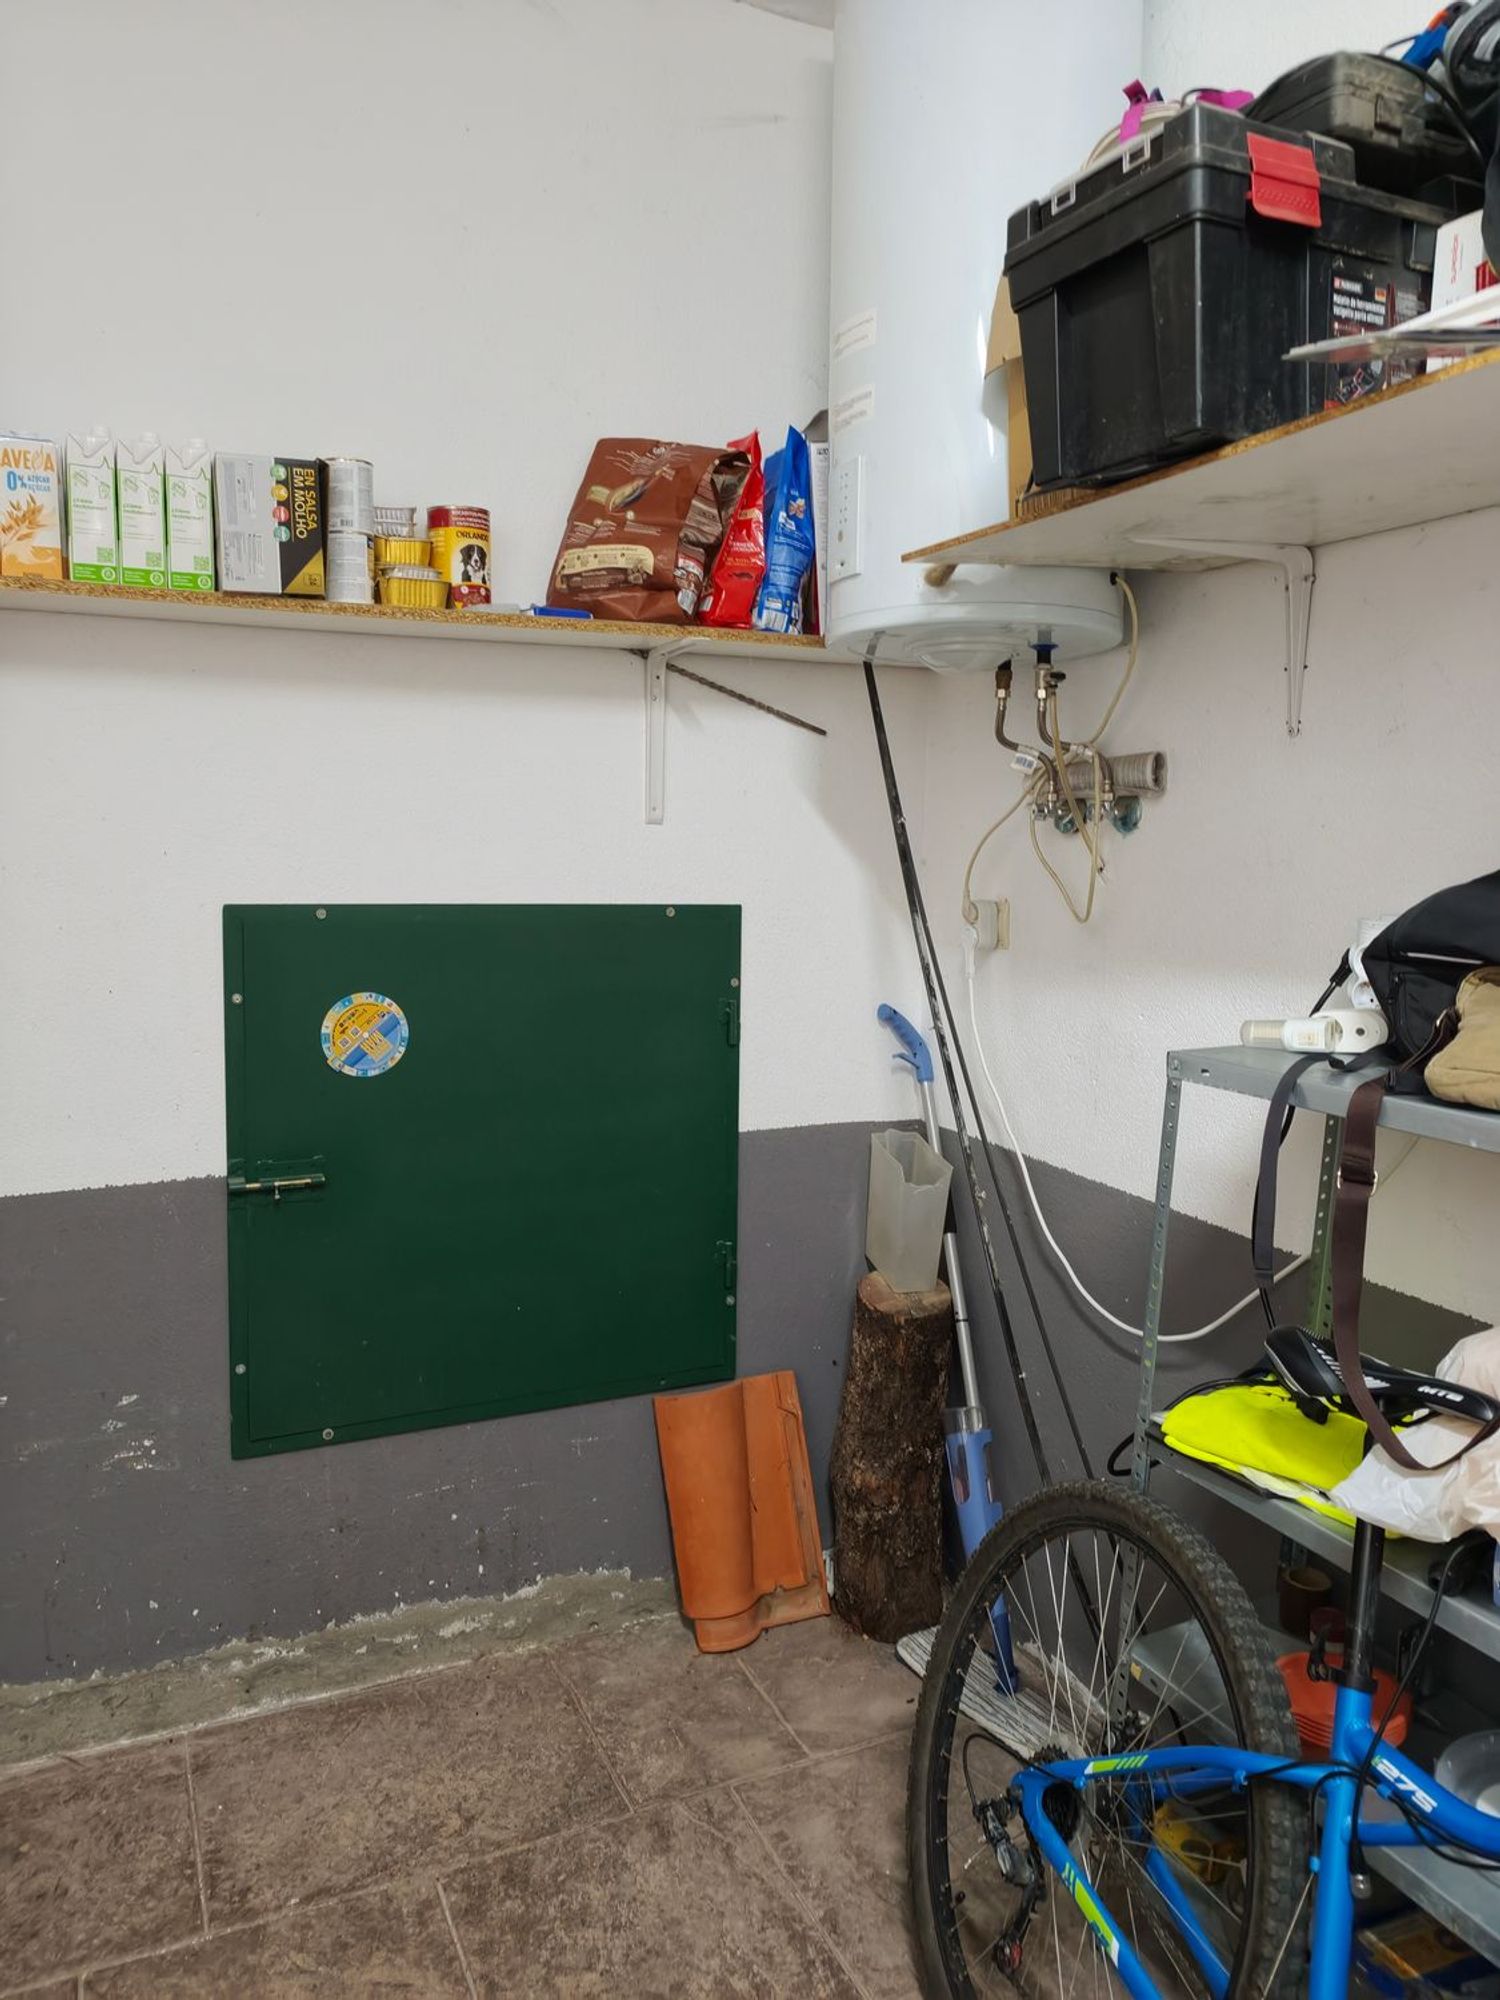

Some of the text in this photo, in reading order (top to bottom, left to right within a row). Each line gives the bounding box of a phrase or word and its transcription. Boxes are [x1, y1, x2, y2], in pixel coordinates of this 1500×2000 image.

[1, 447, 54, 471] AVENA
[7, 470, 27, 491] 0%
[293, 468, 308, 539] EM MOLHO
[304, 468, 318, 531] EN SALSA
